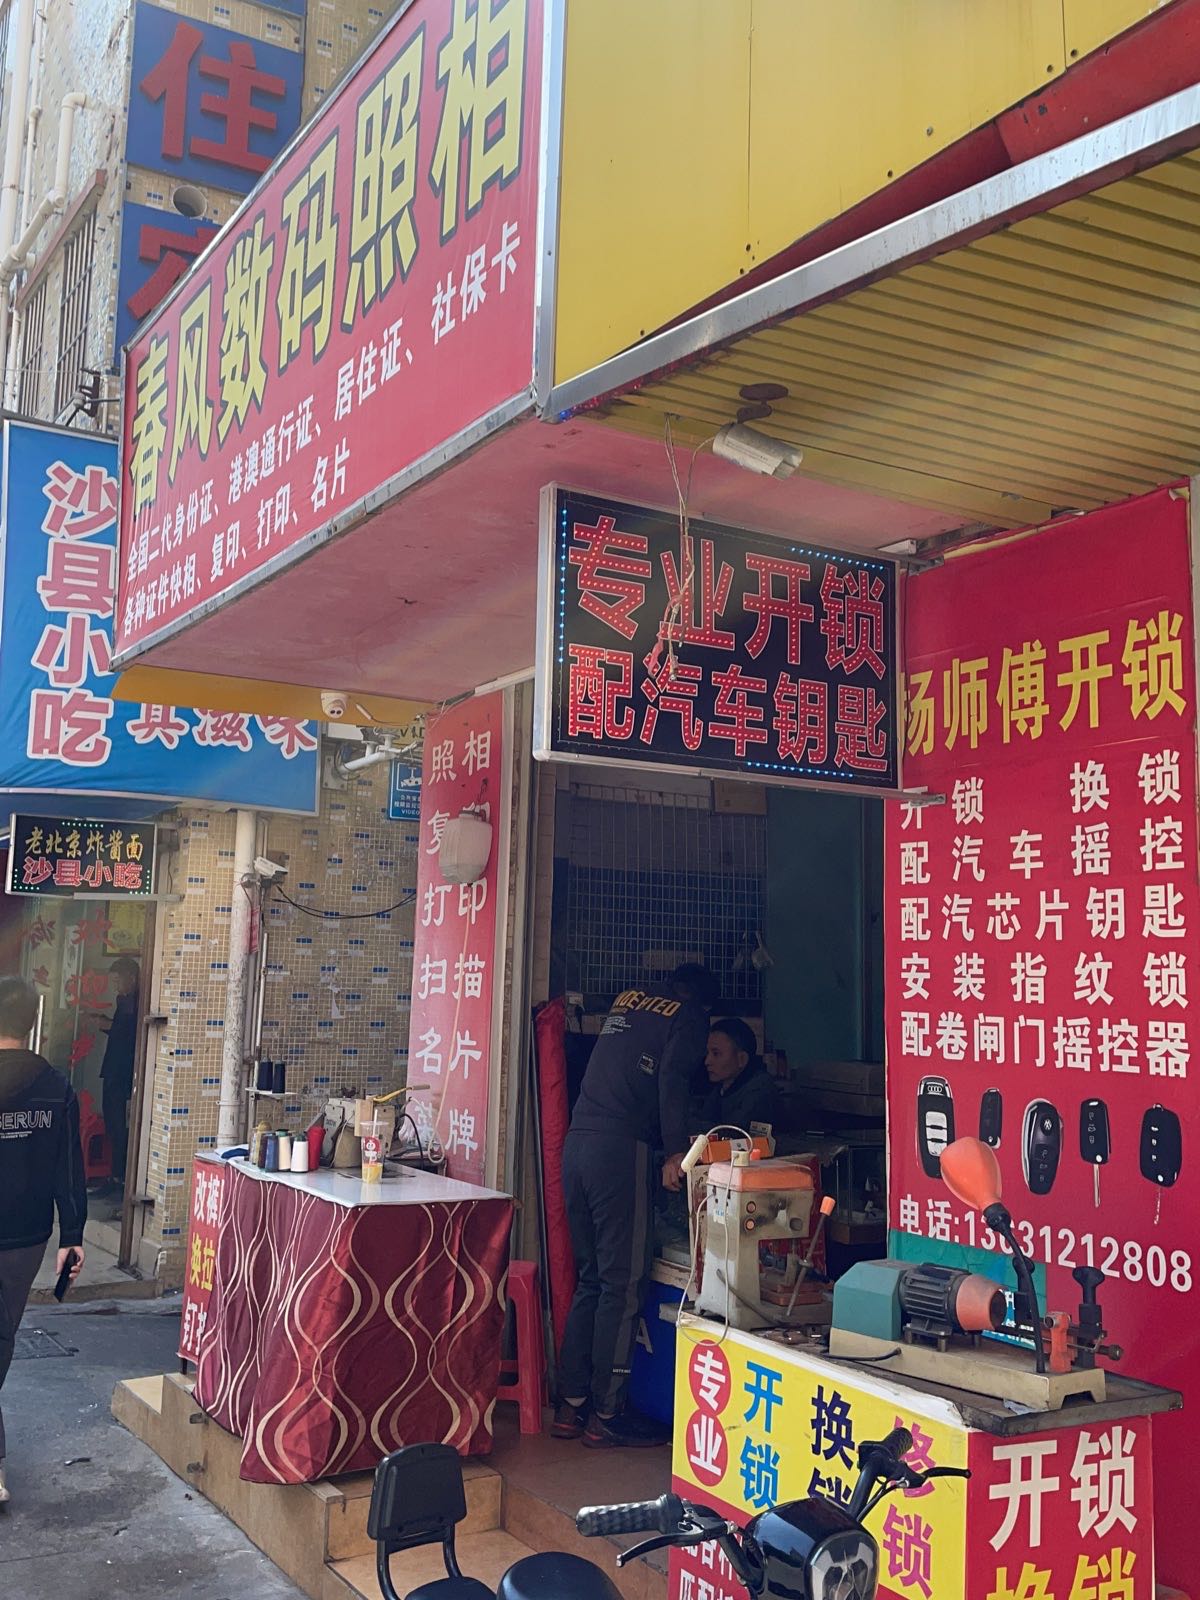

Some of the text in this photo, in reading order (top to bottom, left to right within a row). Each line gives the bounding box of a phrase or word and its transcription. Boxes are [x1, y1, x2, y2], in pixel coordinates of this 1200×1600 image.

[130, 0, 526, 516] 春风数码照相
[28, 461, 118, 766] 沙县小吃
[568, 515, 886, 680] 专业开锁
[568, 643, 887, 772] 配汽车钥匙
[428, 729, 491, 785] 照相
[22, 856, 143, 889] 沙县小吃
[900, 815, 1185, 886] 配汽车摇控
[421, 877, 487, 928] 打印
[900, 882, 1187, 942] 配汽芯片钥匙
[418, 953, 486, 1001] 扫描
[900, 951, 1189, 1009] 安装指纹锁
[414, 1028, 483, 1079] 名片
[900, 1010, 1191, 1078] 配卷闸门摇控器
[0, 1110, 52, 1130] ERUN
[193, 1171, 224, 1228] 改裤
[690, 1349, 725, 1476] 专业
[740, 1361, 784, 1510] 开锁
[989, 1426, 1138, 1552] 开锁
